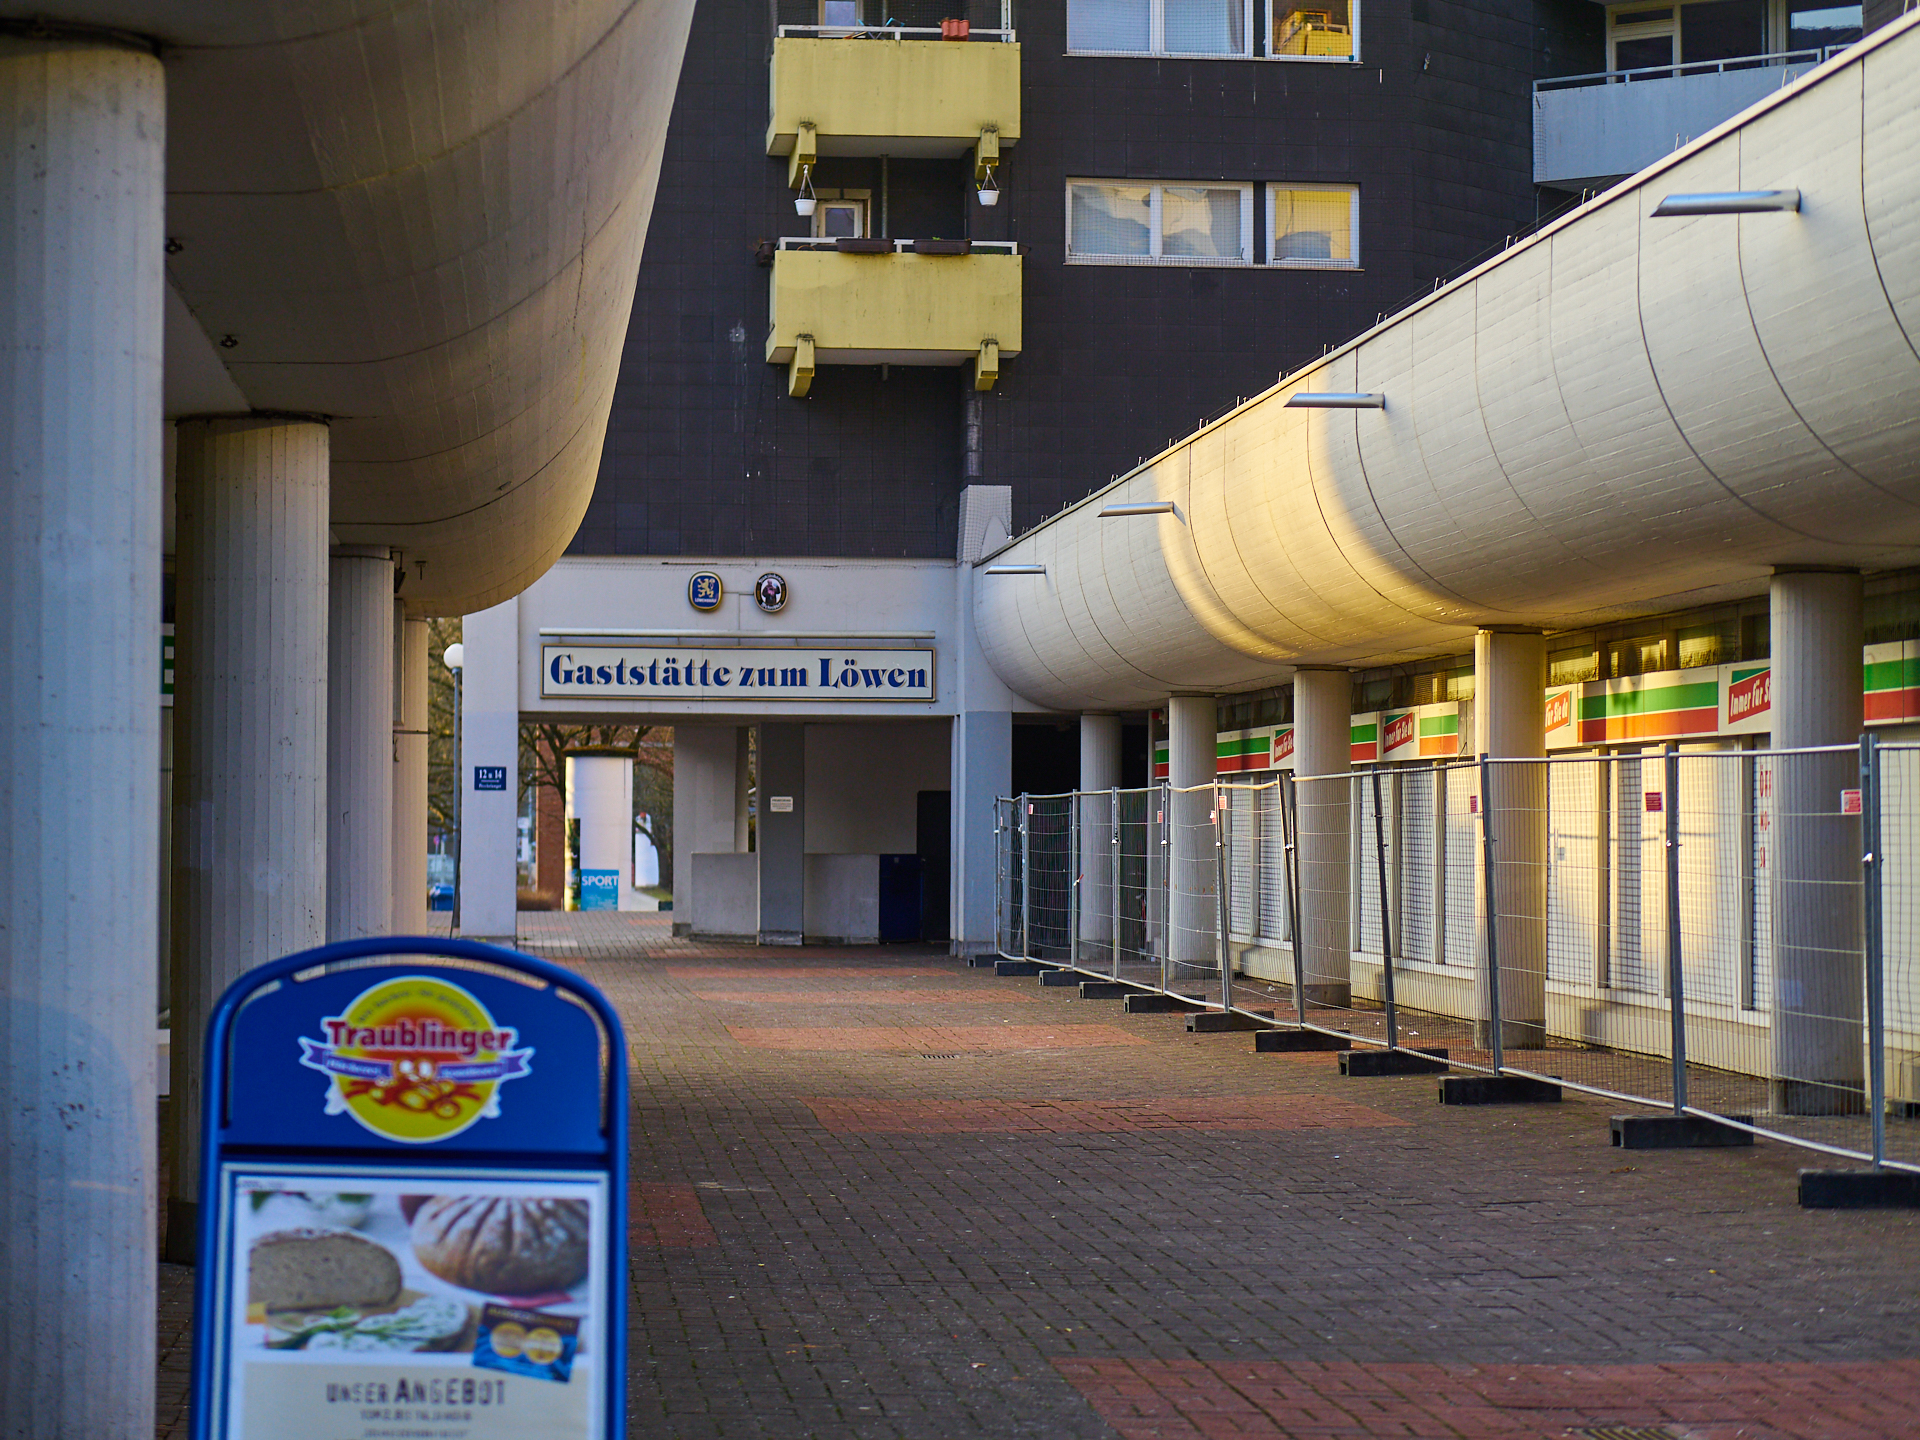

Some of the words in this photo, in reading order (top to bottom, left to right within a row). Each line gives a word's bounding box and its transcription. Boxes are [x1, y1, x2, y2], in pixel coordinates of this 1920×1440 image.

[550, 653, 732, 687] Gaststätte
[739, 663, 809, 688] zum
[818, 657, 929, 689] Löwen
[1730, 691, 1752, 717] Immer
[479, 769, 488, 779] 12
[494, 769, 502, 779] 14
[581, 875, 619, 887] SPORT
[326, 1020, 513, 1056] Traublinger
[326, 1381, 391, 1404] UNSER
[394, 1376, 507, 1406] ANGEBOT
